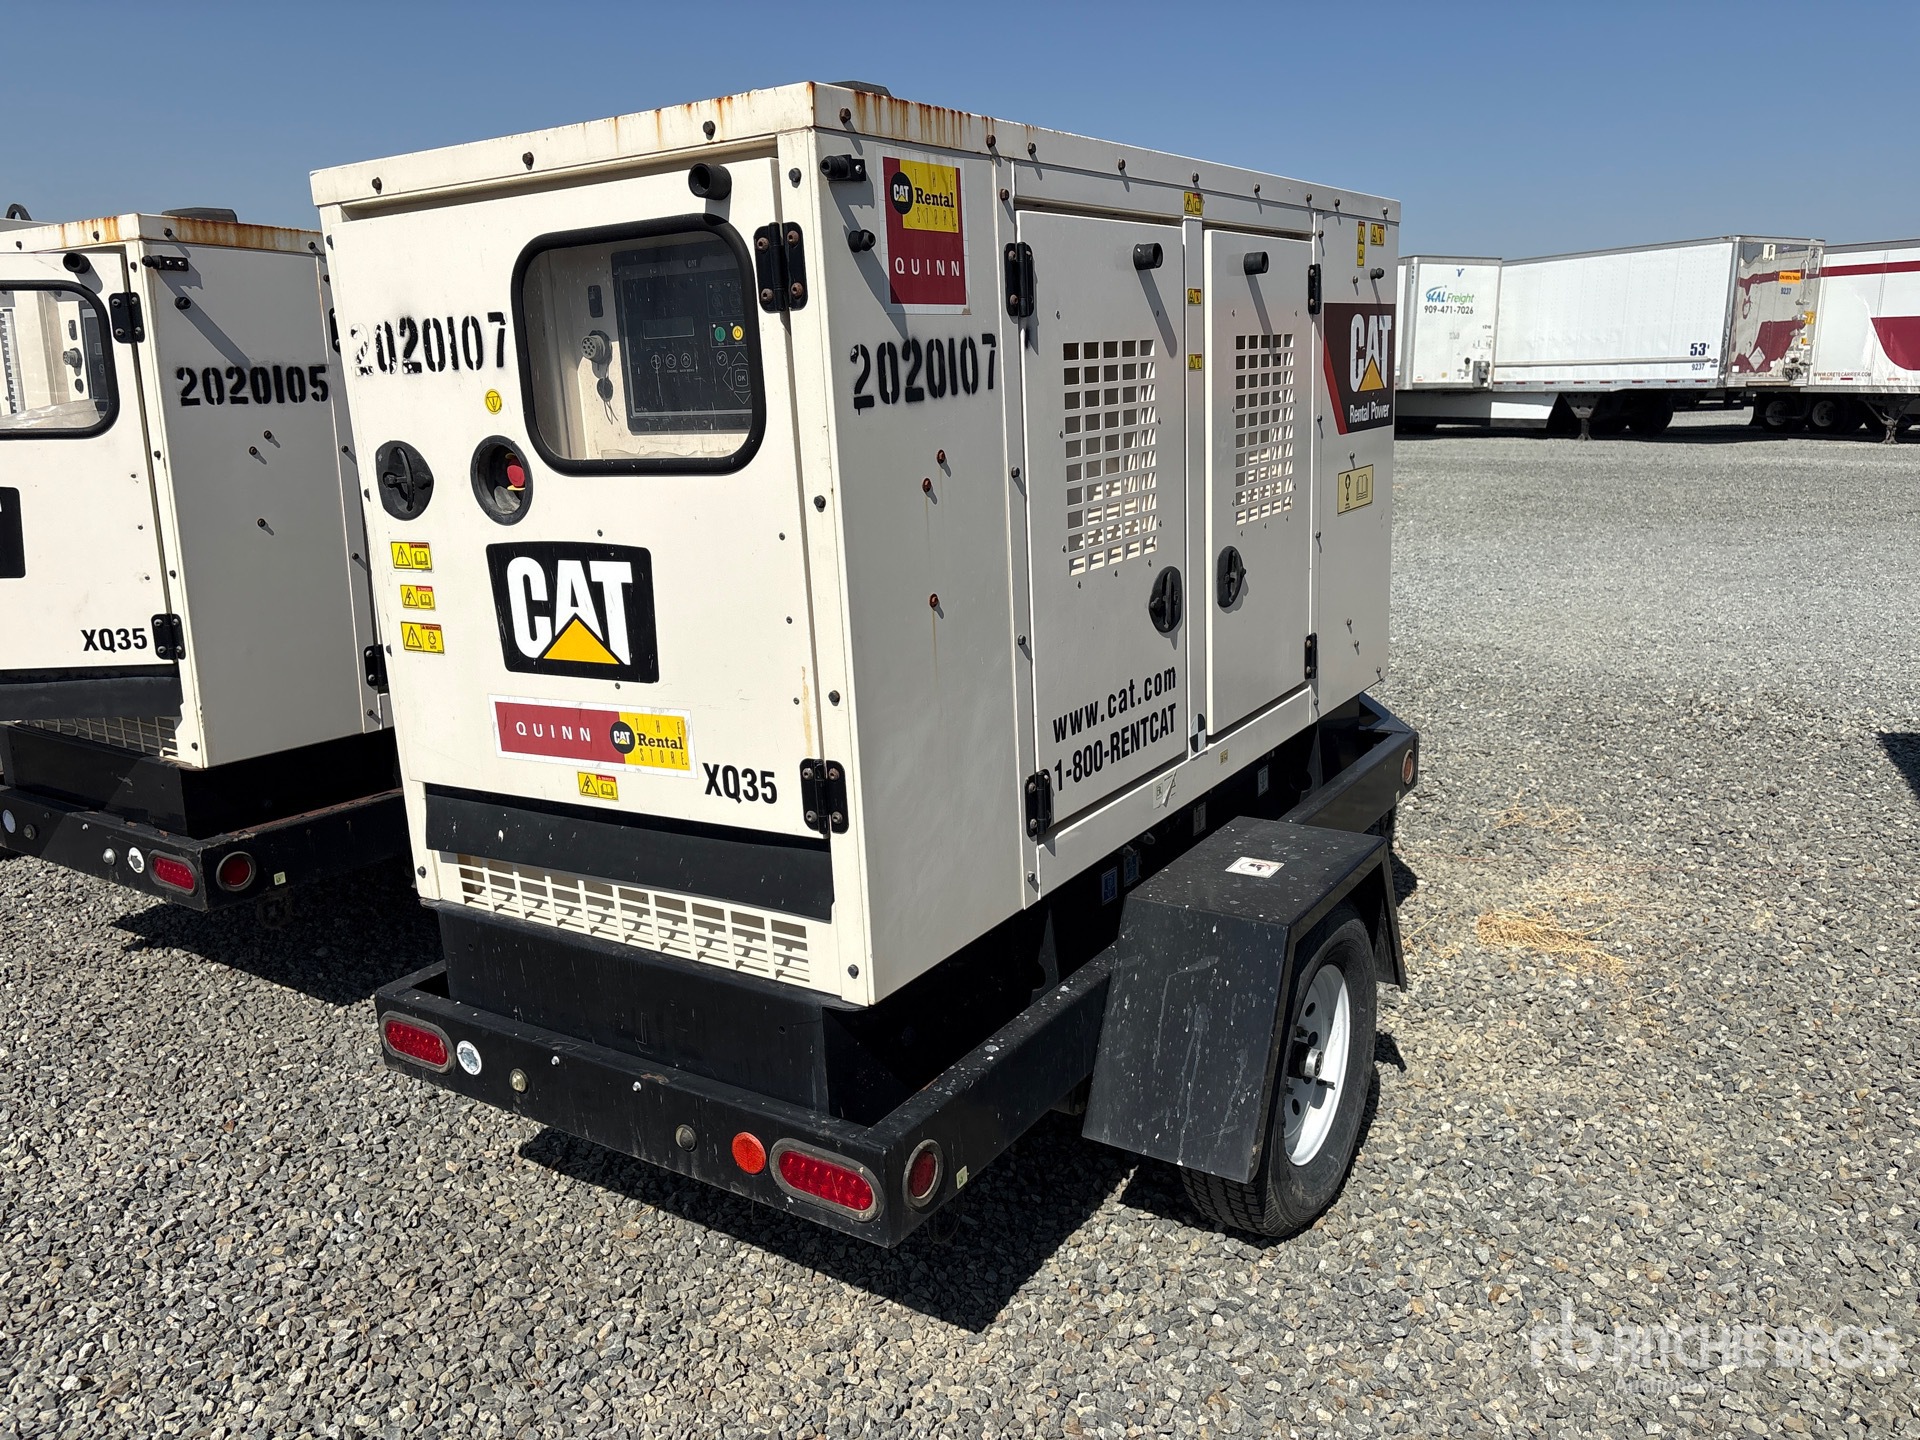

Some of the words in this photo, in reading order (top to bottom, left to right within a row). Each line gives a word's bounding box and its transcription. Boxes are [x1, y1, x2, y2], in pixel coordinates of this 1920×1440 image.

[893, 183, 910, 203] CAT
[914, 186, 955, 208] Rental
[894, 257, 960, 277] QUINN
[1424, 305, 1474, 314] 909-471-7026
[1446, 292, 1475, 305] Freight
[1350, 313, 1392, 393] CAT
[850, 333, 997, 409] 2020107
[1691, 362, 1705, 371] 9237
[175, 364, 329, 407] 2020105
[1349, 402, 1370, 424] Rental
[1370, 401, 1390, 420] Power
[506, 556, 633, 666] CAT
[81, 627, 148, 653] XQ35
[1052, 666, 1176, 744] www.cat.com
[515, 721, 591, 742] QUINN
[635, 717, 681, 736] THE
[613, 730, 631, 745] CAT
[636, 733, 684, 750] Rental
[1054, 703, 1176, 792] 1-800-RENTCAT
[702, 762, 778, 804] XQ35
